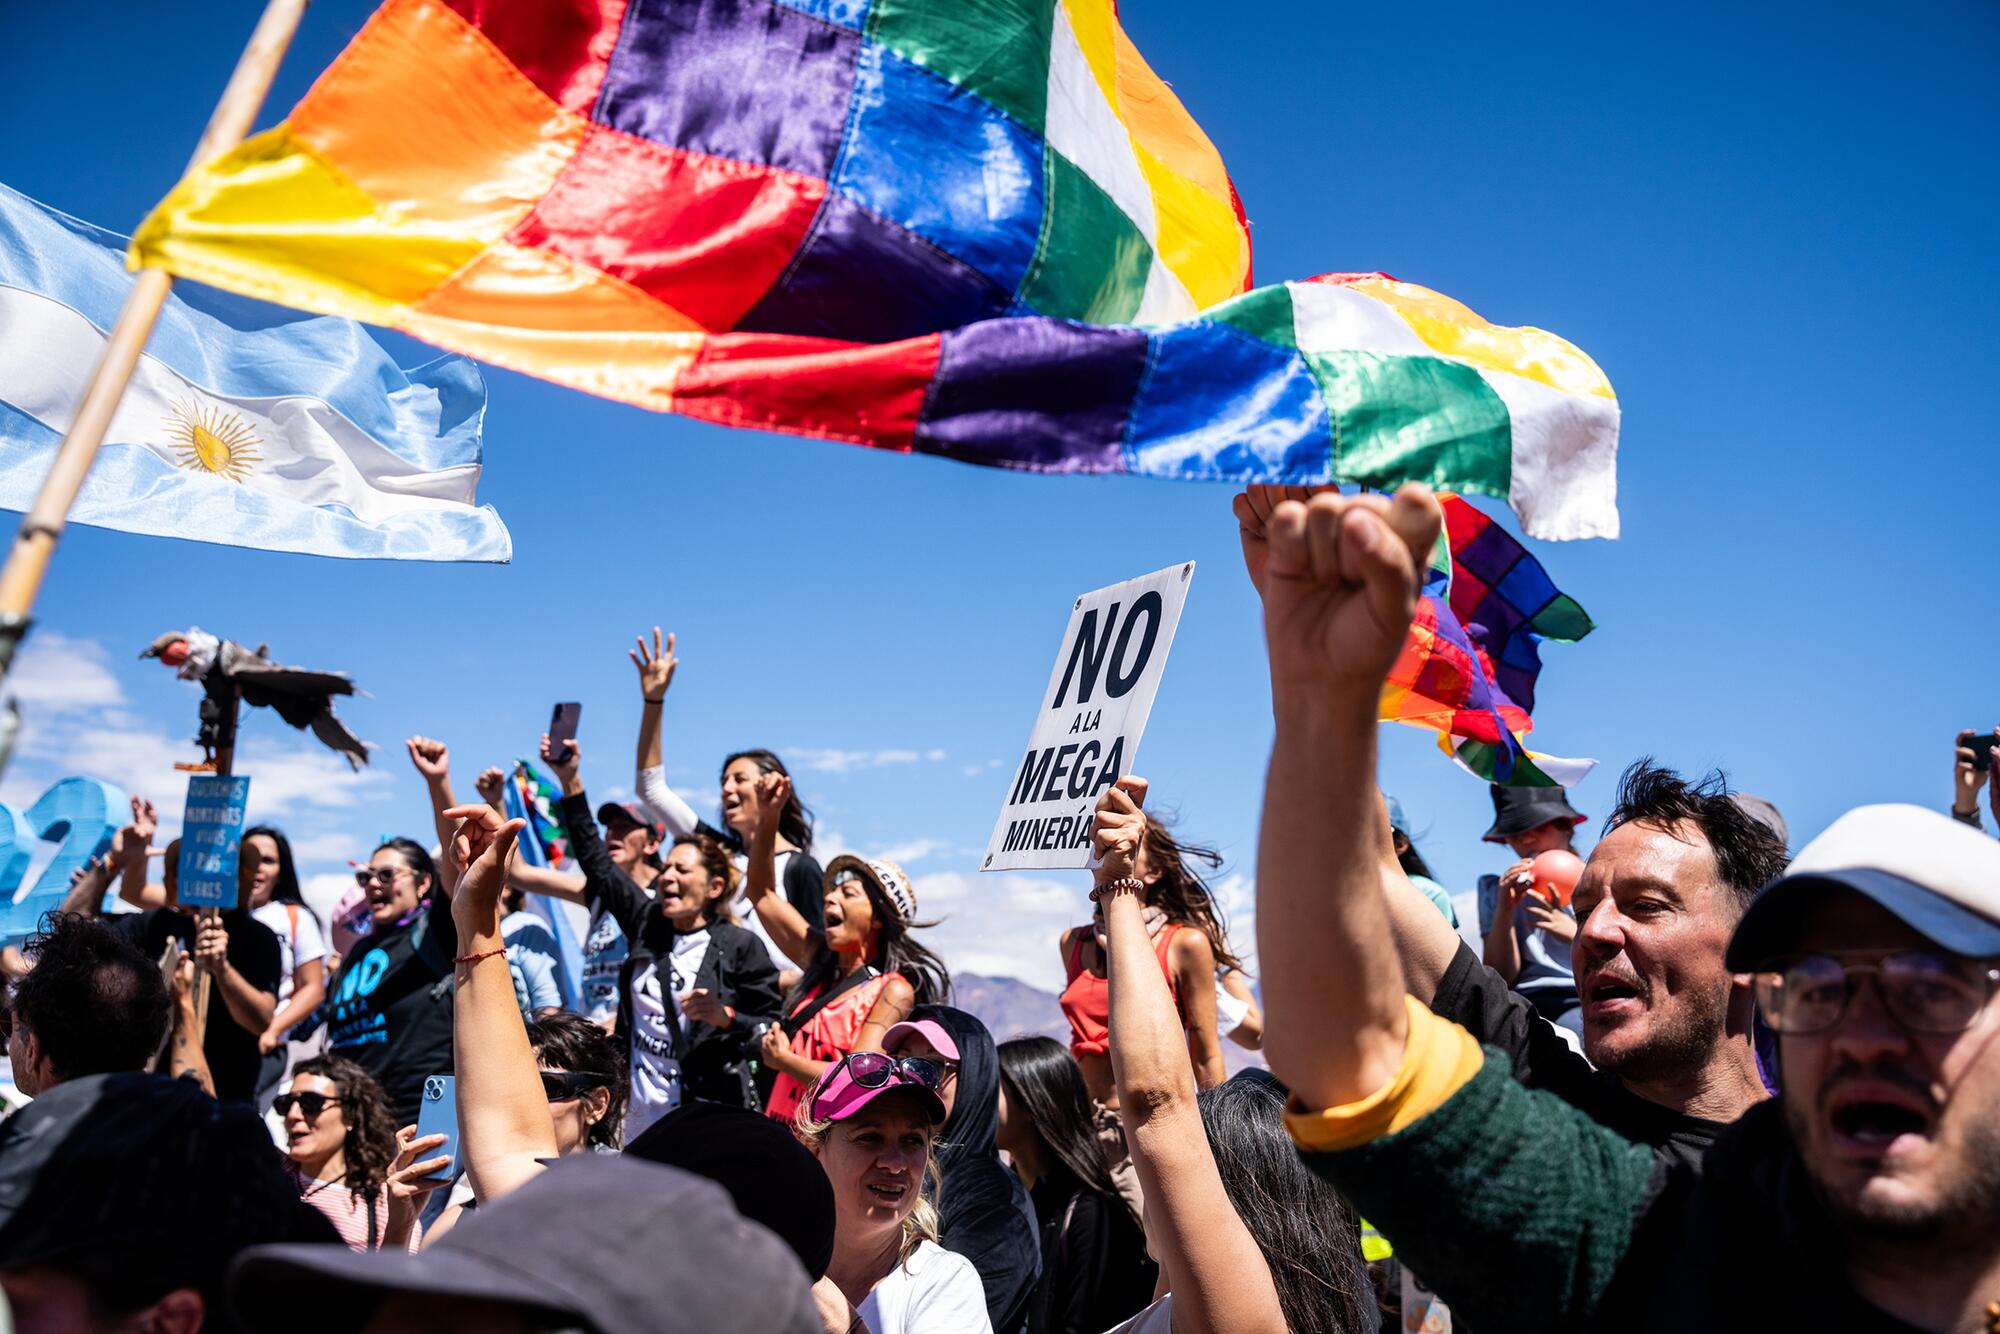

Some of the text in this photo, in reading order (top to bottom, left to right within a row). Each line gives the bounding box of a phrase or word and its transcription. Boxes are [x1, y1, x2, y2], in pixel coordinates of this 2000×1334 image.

[1052, 591, 1162, 709] NO
[1069, 709, 1102, 735] A LA
[1009, 736, 1125, 806] MEGA
[1001, 805, 1095, 852] MINERÍA
[334, 948, 390, 1006] NO
